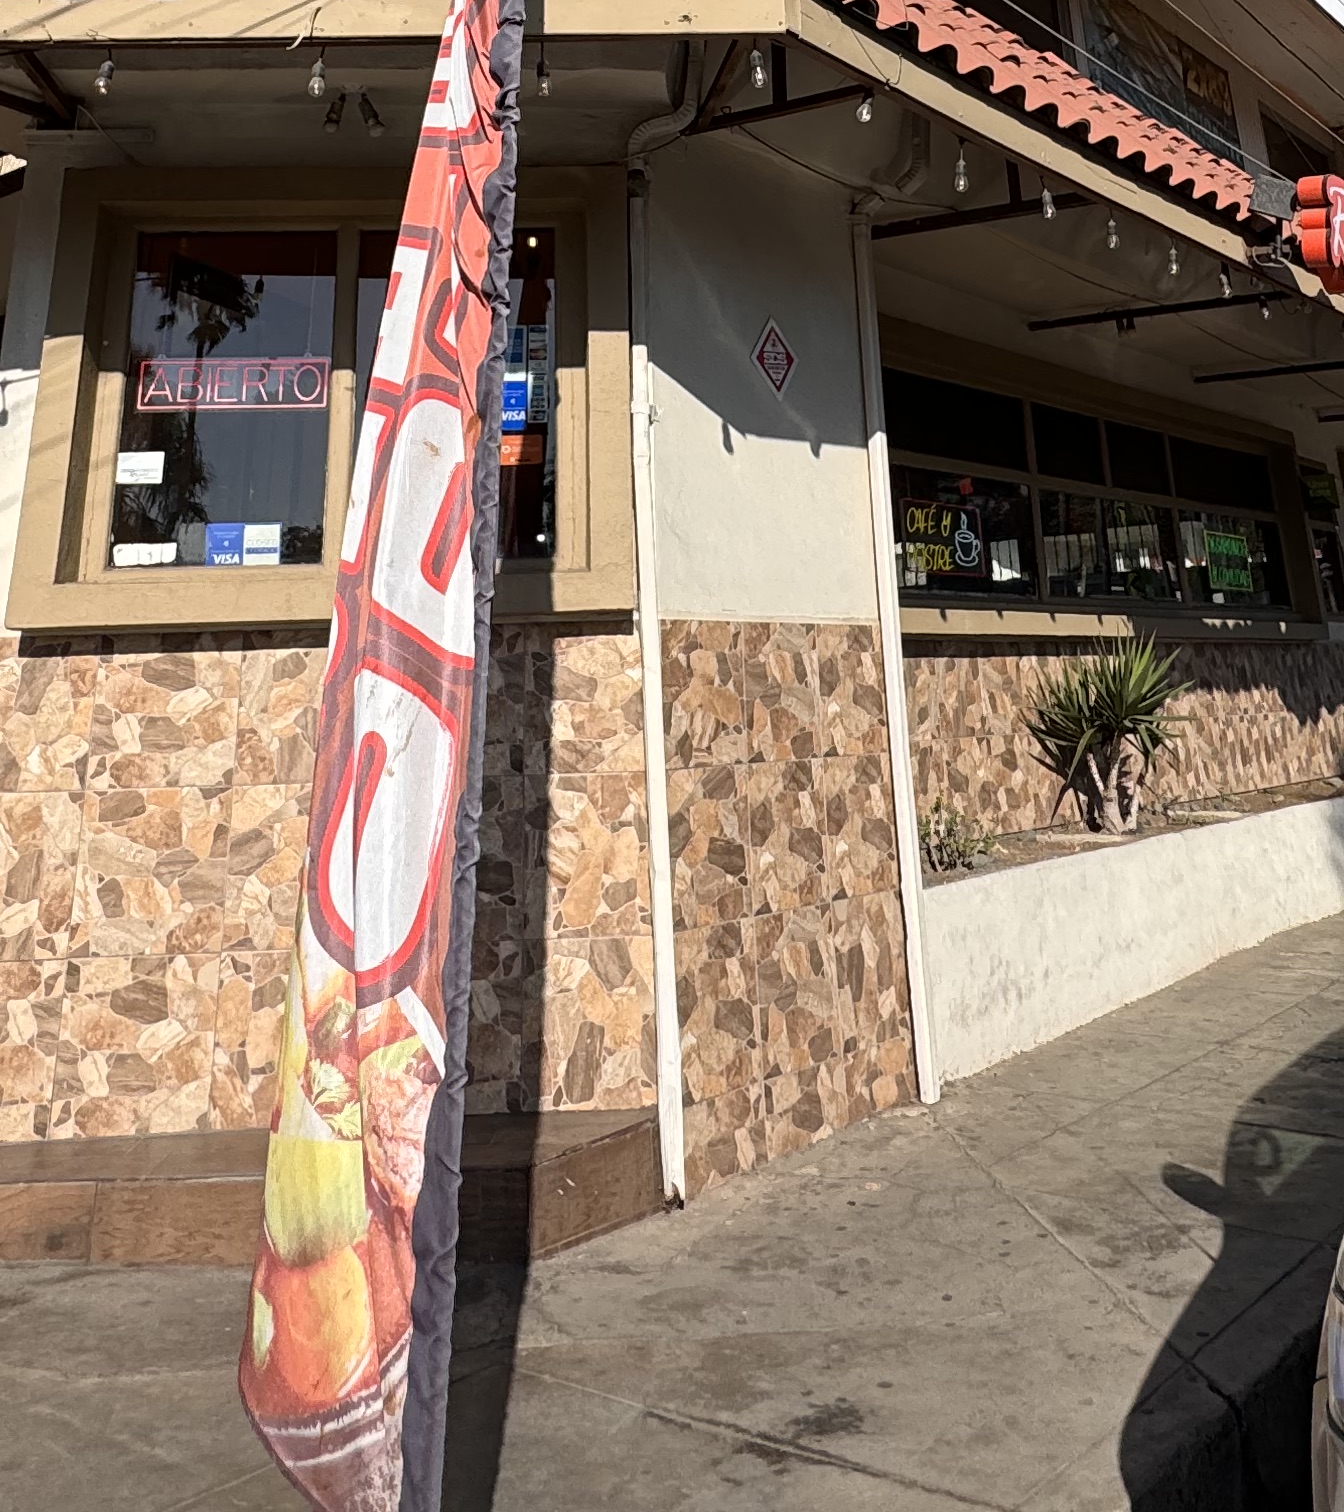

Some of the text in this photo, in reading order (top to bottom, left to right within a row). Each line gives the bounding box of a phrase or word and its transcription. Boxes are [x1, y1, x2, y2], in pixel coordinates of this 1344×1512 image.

[143, 365, 322, 404] ABIERTO
[502, 410, 526, 422] VISA
[213, 553, 240, 564] VISA
